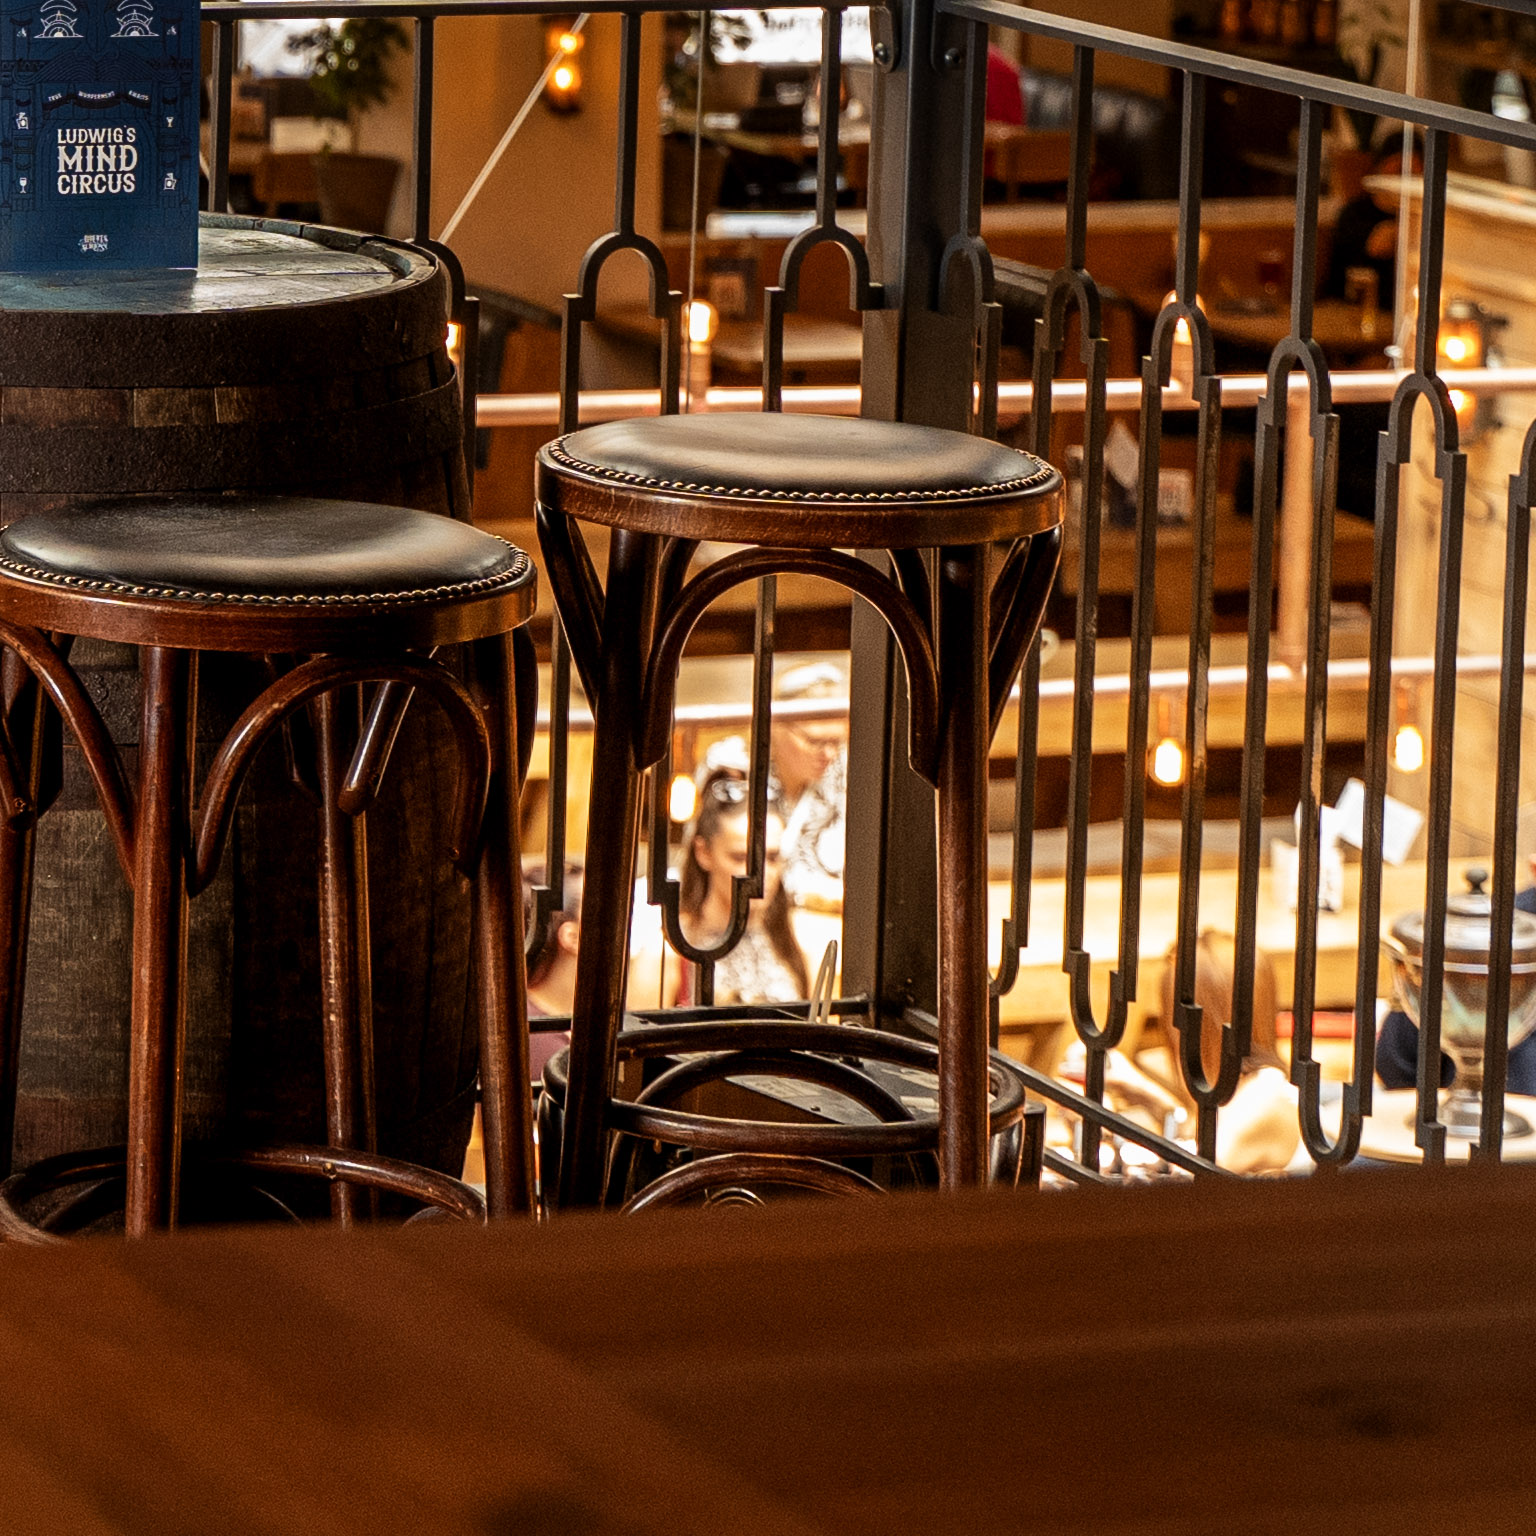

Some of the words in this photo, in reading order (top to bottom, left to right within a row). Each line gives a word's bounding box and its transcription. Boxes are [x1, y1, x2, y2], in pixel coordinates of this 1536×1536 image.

[57, 125, 136, 144] LUDWIG'S
[57, 145, 138, 173] MIND
[57, 173, 136, 195] CIRCUS
